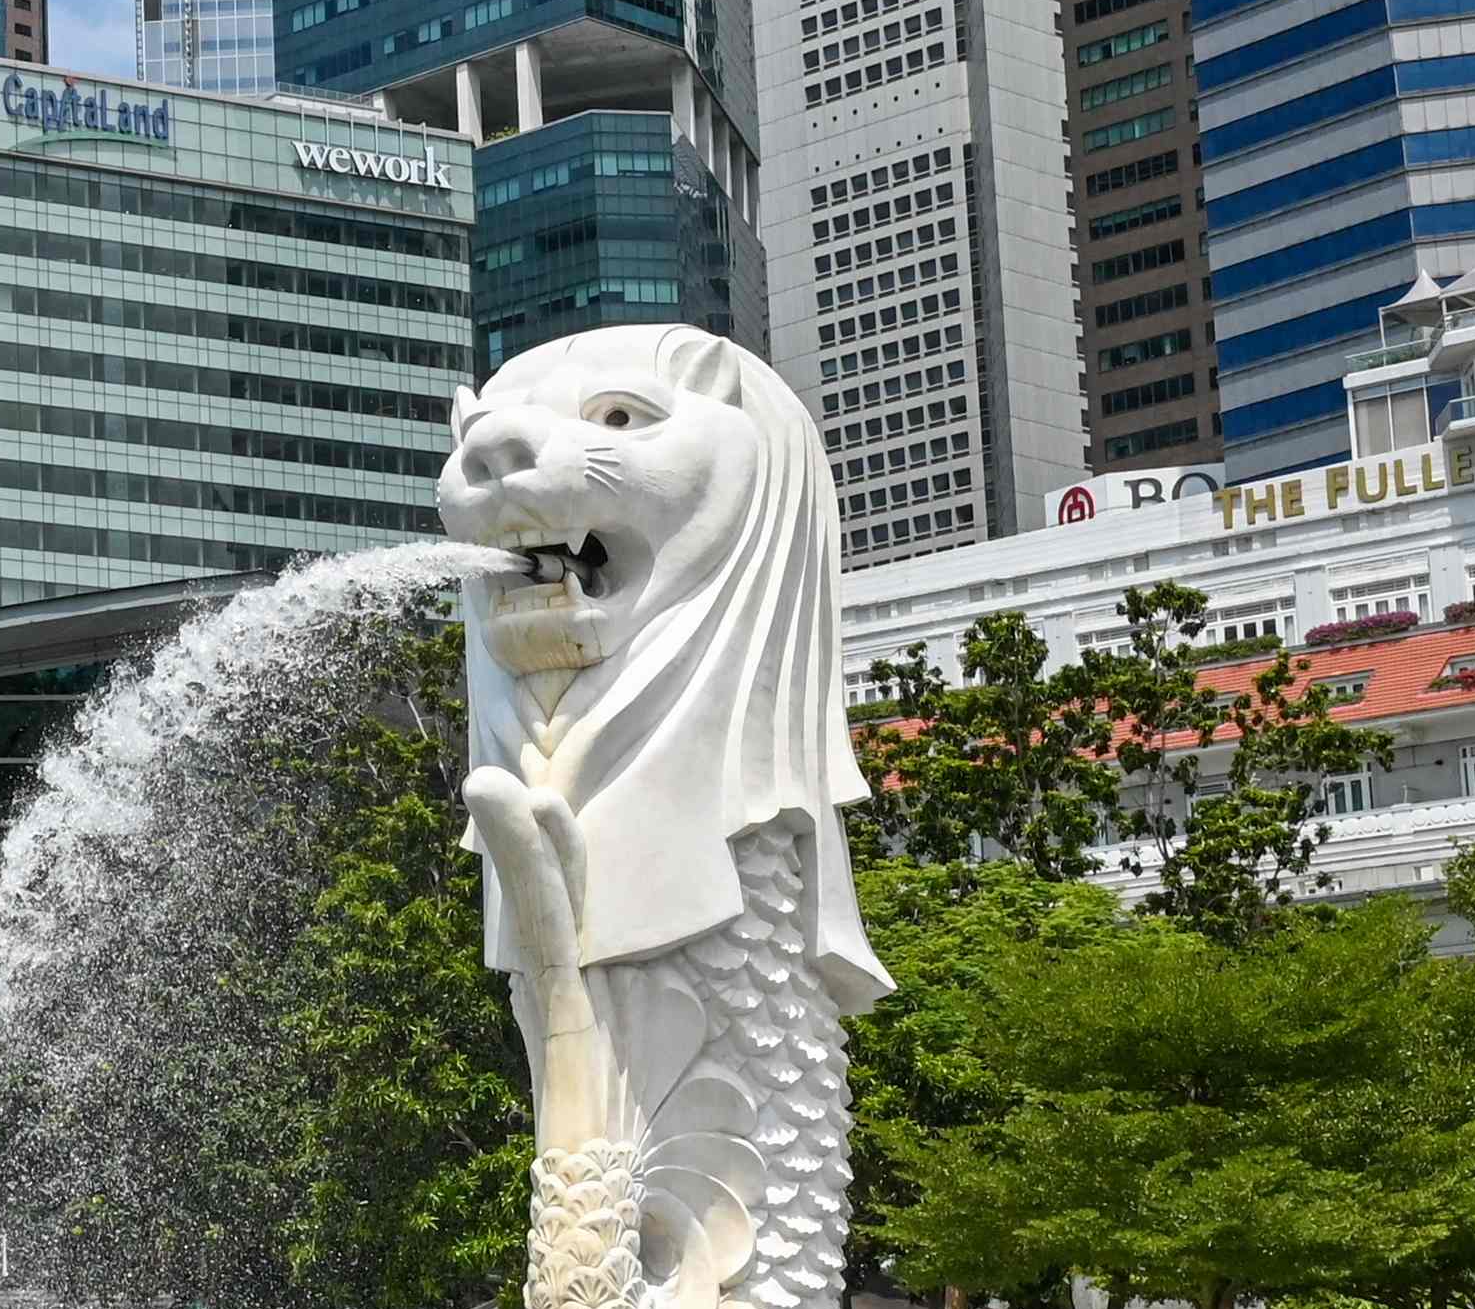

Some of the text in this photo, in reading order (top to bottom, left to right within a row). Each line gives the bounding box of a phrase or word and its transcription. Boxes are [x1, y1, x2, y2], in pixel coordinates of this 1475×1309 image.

[3, 74, 170, 141] CapitaLand
[291, 140, 452, 189] wework
[1213, 478, 1305, 529] THE
